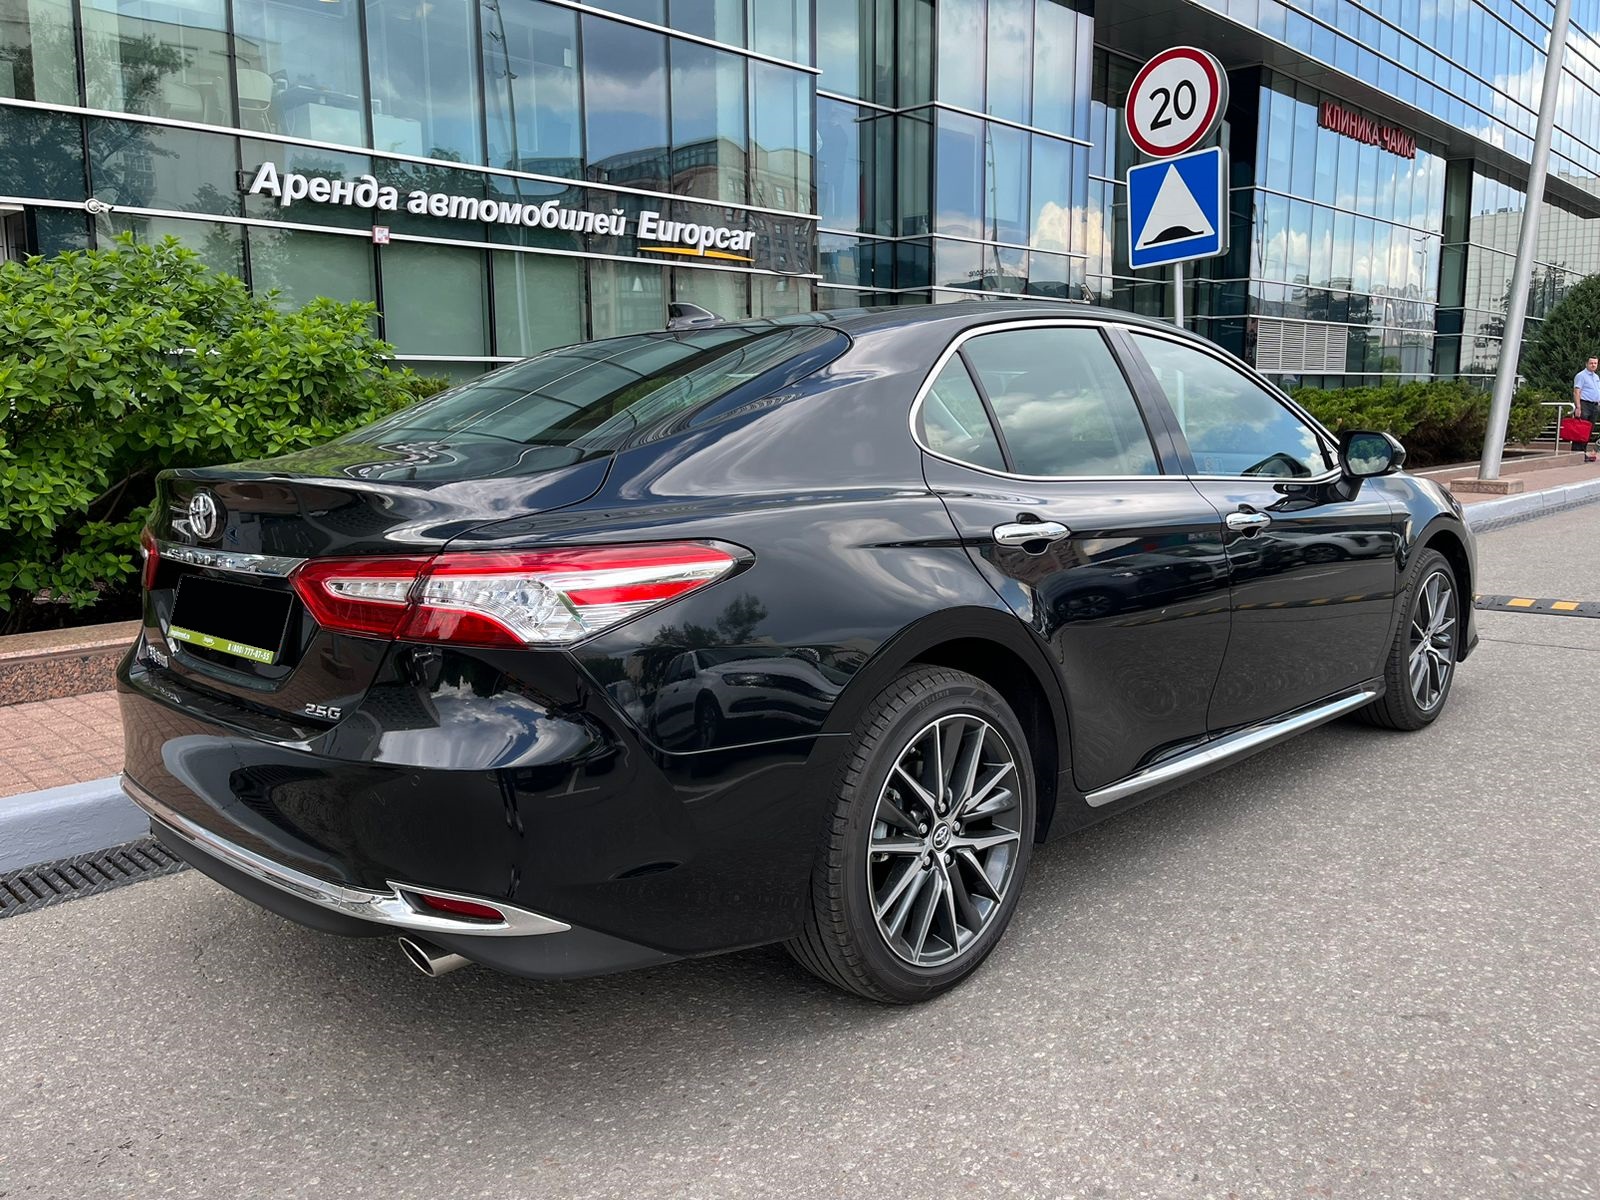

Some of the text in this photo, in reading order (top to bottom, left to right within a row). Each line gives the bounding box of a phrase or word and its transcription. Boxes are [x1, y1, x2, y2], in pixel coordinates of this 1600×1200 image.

[1149, 79, 1196, 131] 20
[1383, 125, 1416, 157] ЧАЙКА
[249, 161, 755, 256] Аренда автомобилей Europcar
